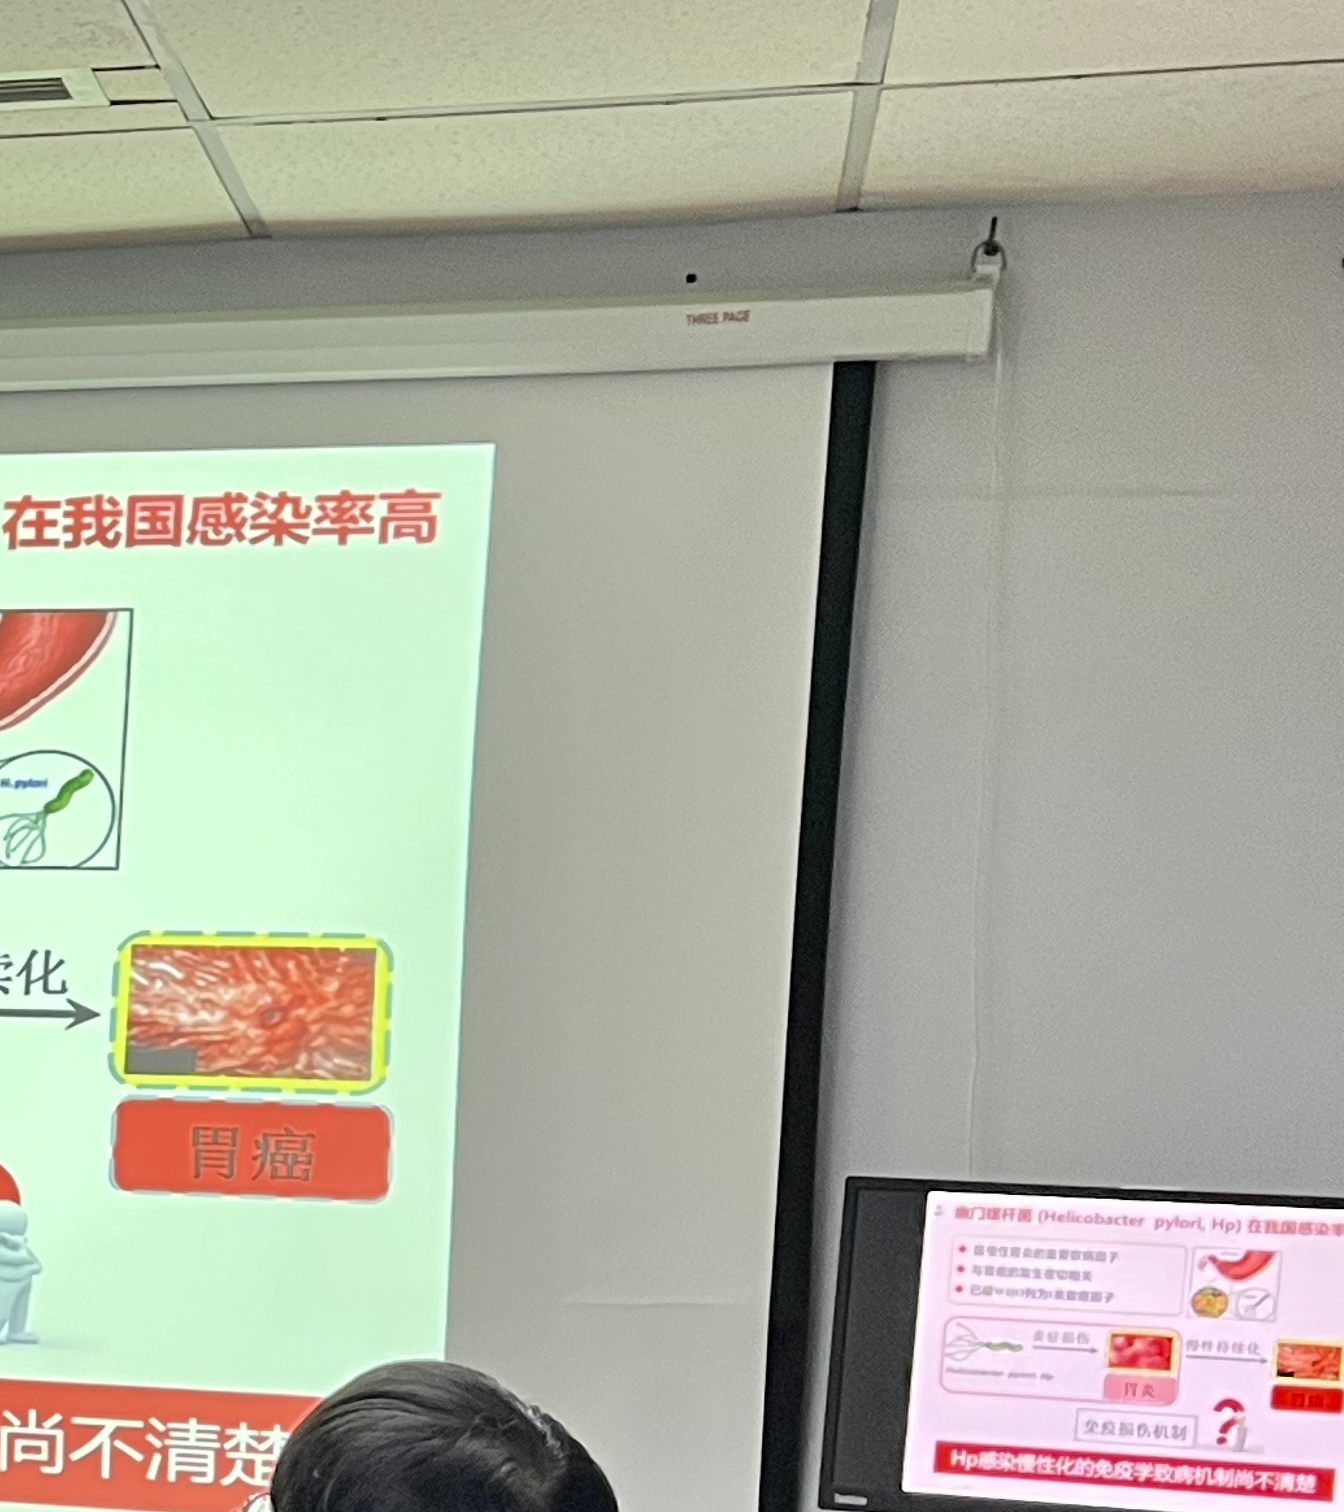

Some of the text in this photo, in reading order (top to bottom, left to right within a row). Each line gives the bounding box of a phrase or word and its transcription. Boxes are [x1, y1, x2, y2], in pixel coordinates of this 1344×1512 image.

[2, 488, 441, 550] 在我国感染率高
[192, 1126, 315, 1181] 胃癌
